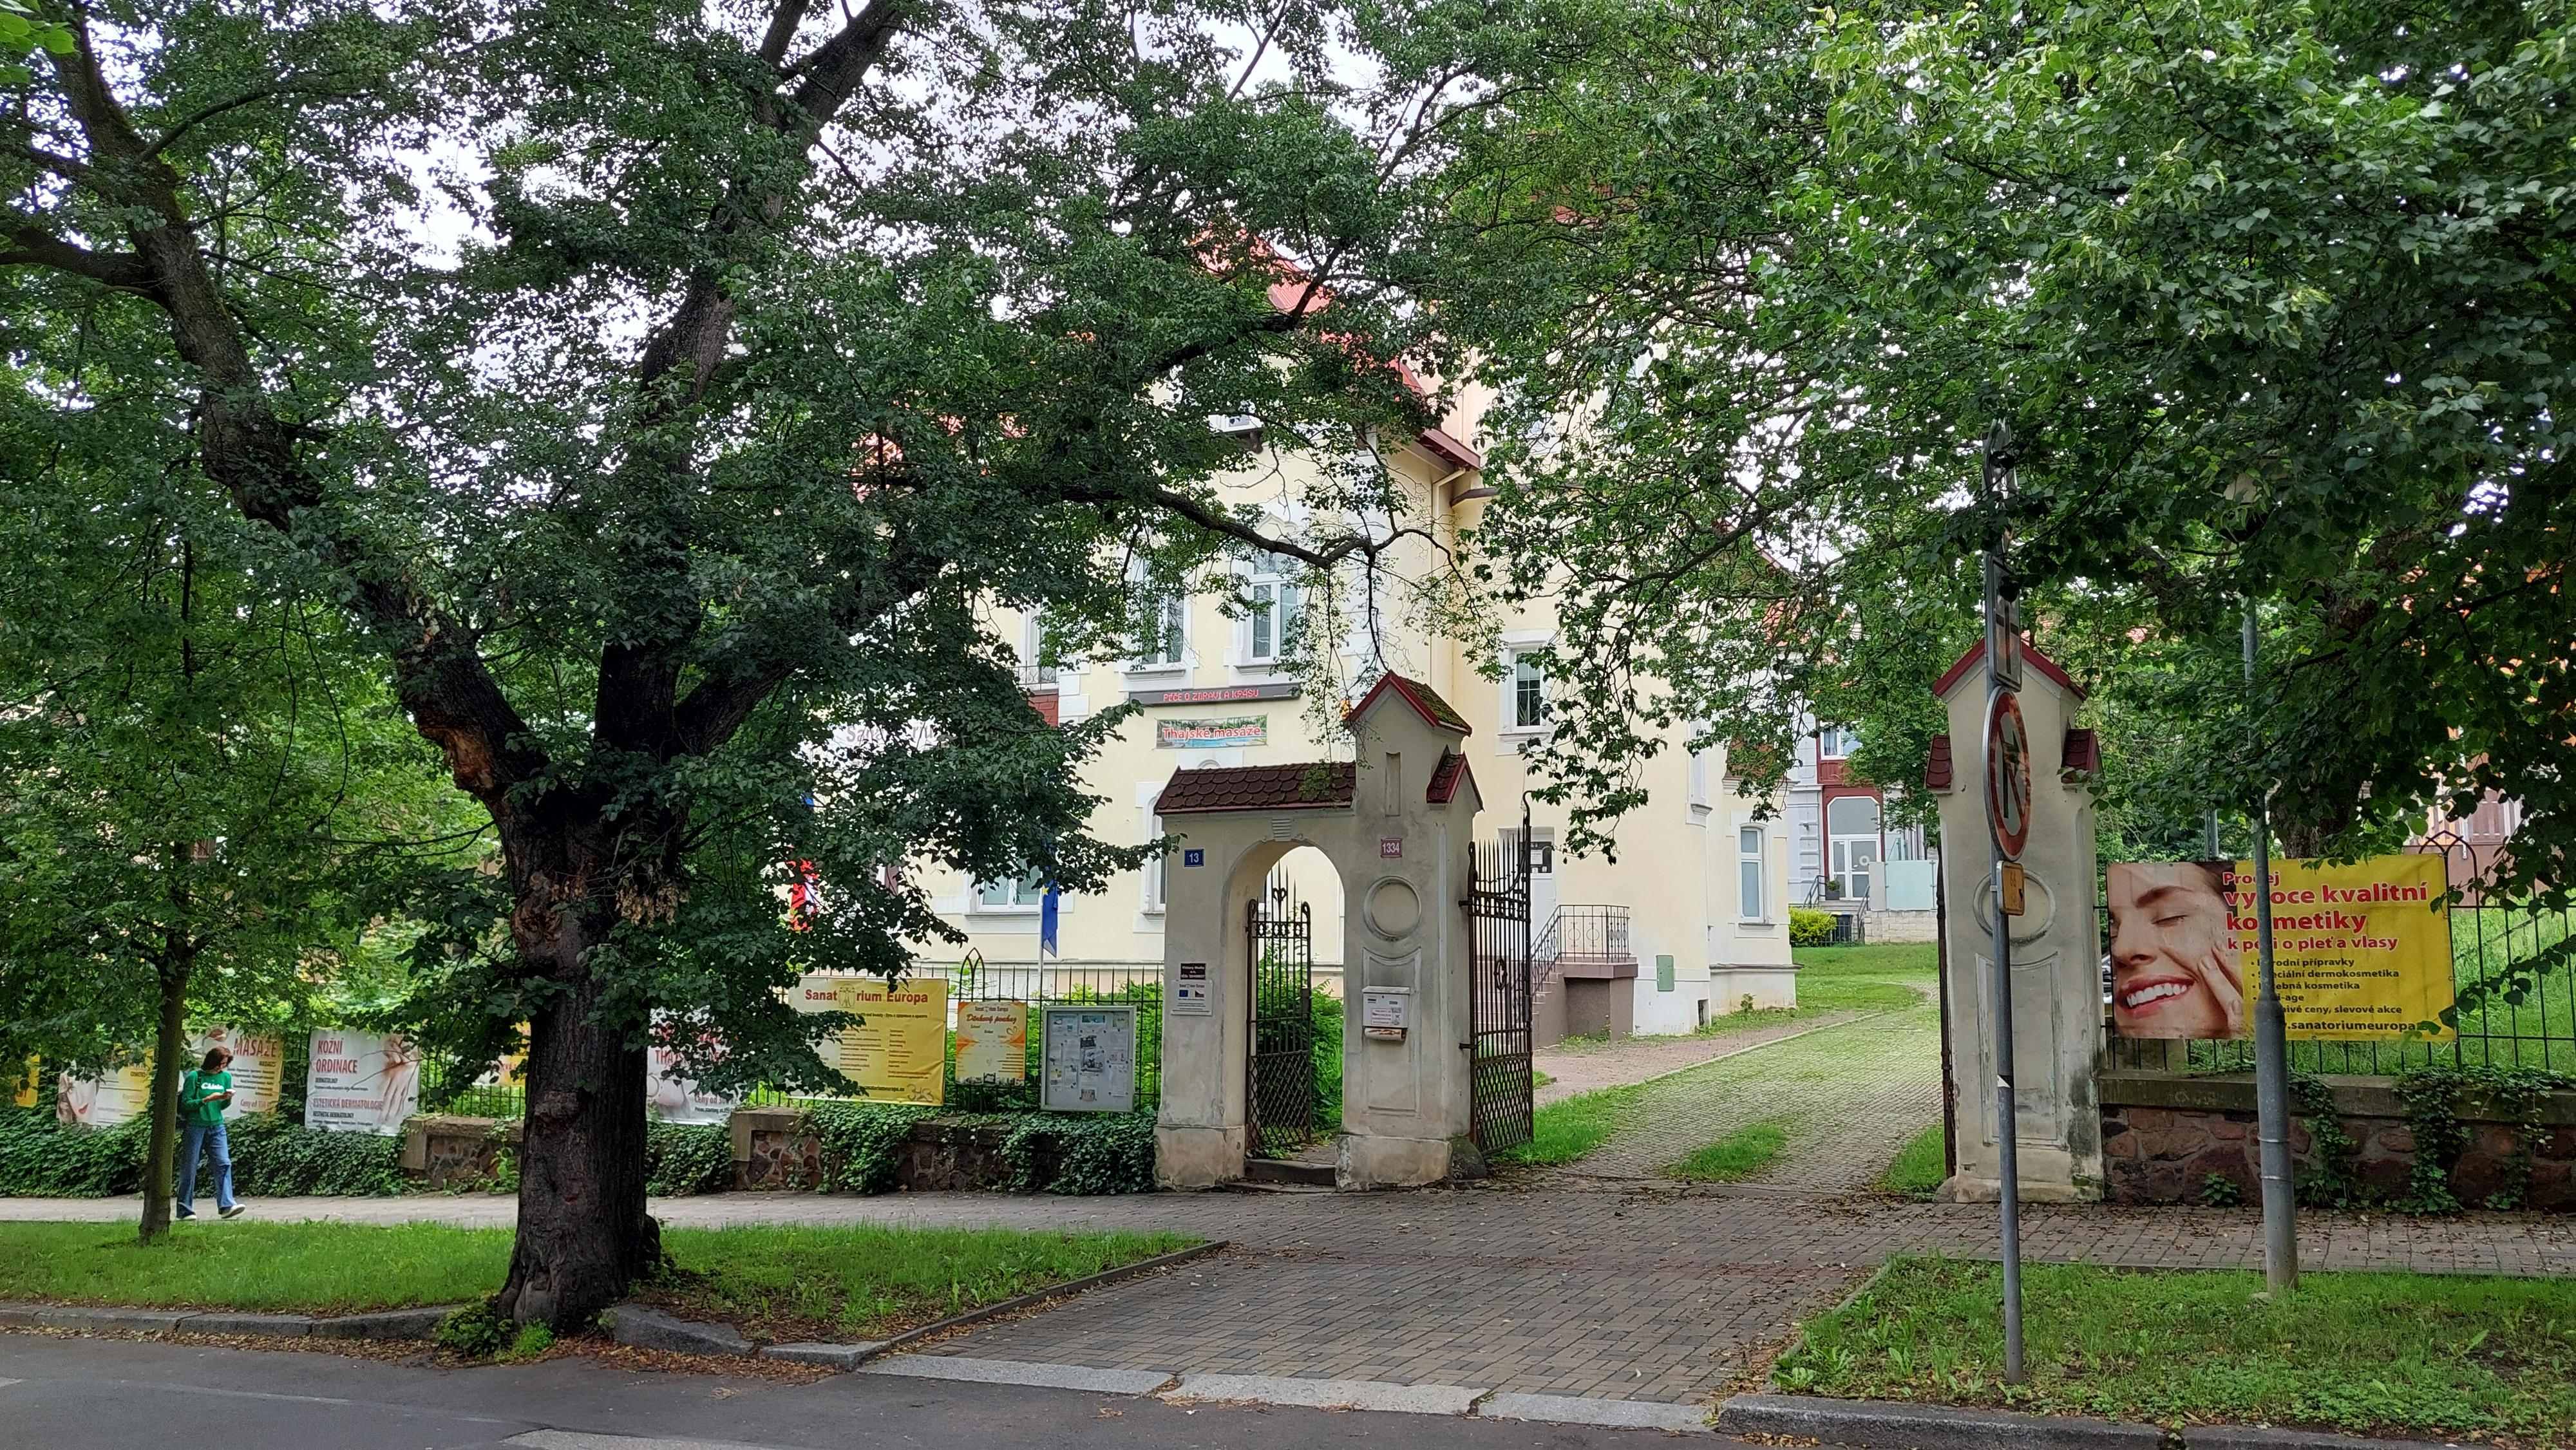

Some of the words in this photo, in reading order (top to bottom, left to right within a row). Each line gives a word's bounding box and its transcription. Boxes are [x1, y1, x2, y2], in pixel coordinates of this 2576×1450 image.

[1184, 692, 1190, 701] O
[1224, 691, 1229, 699] A
[1162, 727, 1211, 741] Thajské
[1214, 724, 1260, 738] masáže
[1382, 842, 1400, 853] 1334
[1189, 852, 1199, 863] 13
[2223, 871, 2280, 887] Proej
[2224, 890, 2315, 910] vyoce
[2322, 881, 2428, 903] kvalitní
[2226, 910, 2367, 934] kometiky
[2228, 937, 2238, 950] k
[2282, 939, 2293, 949] o
[2298, 936, 2333, 952] pleť
[2336, 939, 2347, 948] a
[2351, 936, 2398, 951] vlasy
[2302, 957, 2354, 968] přípravky
[2307, 969, 2400, 978] dermokosmetika
[2304, 981, 2360, 990] kosmetika
[887, 992, 929, 1006] Europa
[2305, 1006, 2331, 1015] ceny,
[2334, 1005, 2375, 1013] slevové
[2377, 1005, 2403, 1013] akce
[317, 1038, 344, 1055] KOŽNÍ
[316, 1059, 358, 1074] ORDINACE
